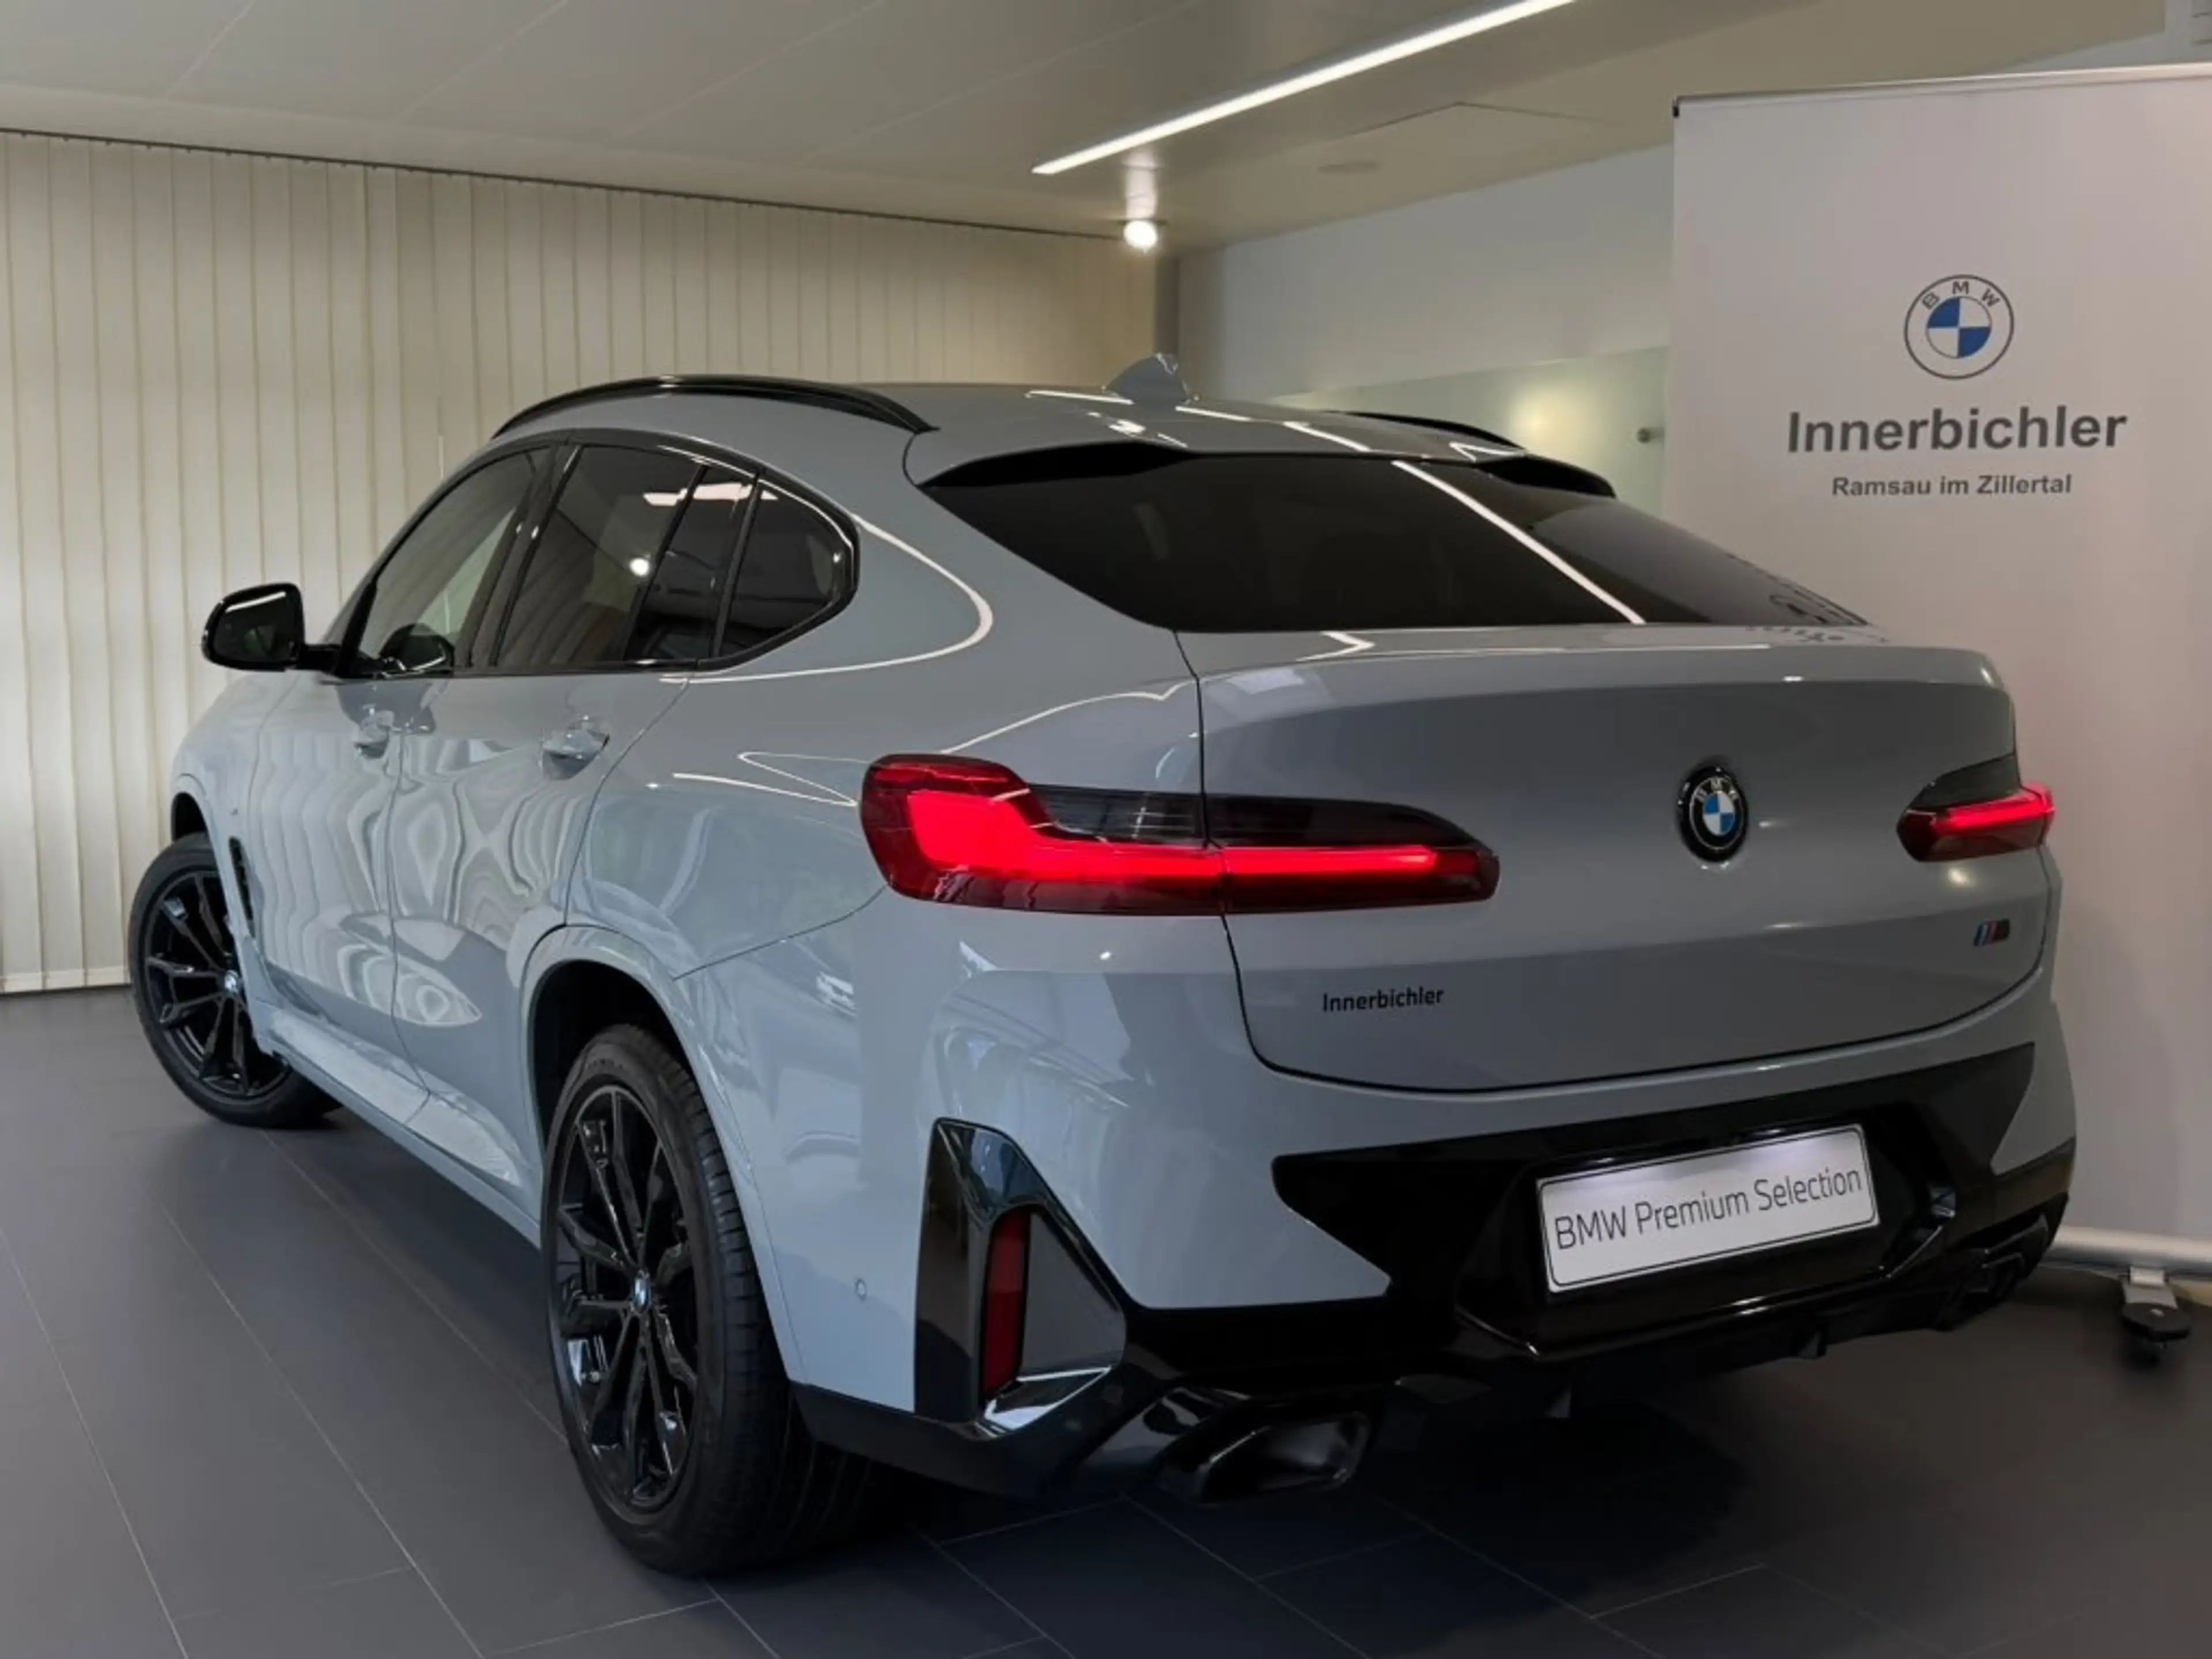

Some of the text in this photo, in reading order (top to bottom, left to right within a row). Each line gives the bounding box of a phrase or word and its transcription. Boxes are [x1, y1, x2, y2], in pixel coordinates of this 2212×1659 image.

[1922, 281, 2001, 310] BMW
[1787, 405, 2128, 453] Innerbichler
[1832, 474, 2072, 497] Ramsau im Zillertal
[1323, 986, 1445, 1012] Innerbichler
[1555, 1166, 1861, 1250] BMW Premium Selection
